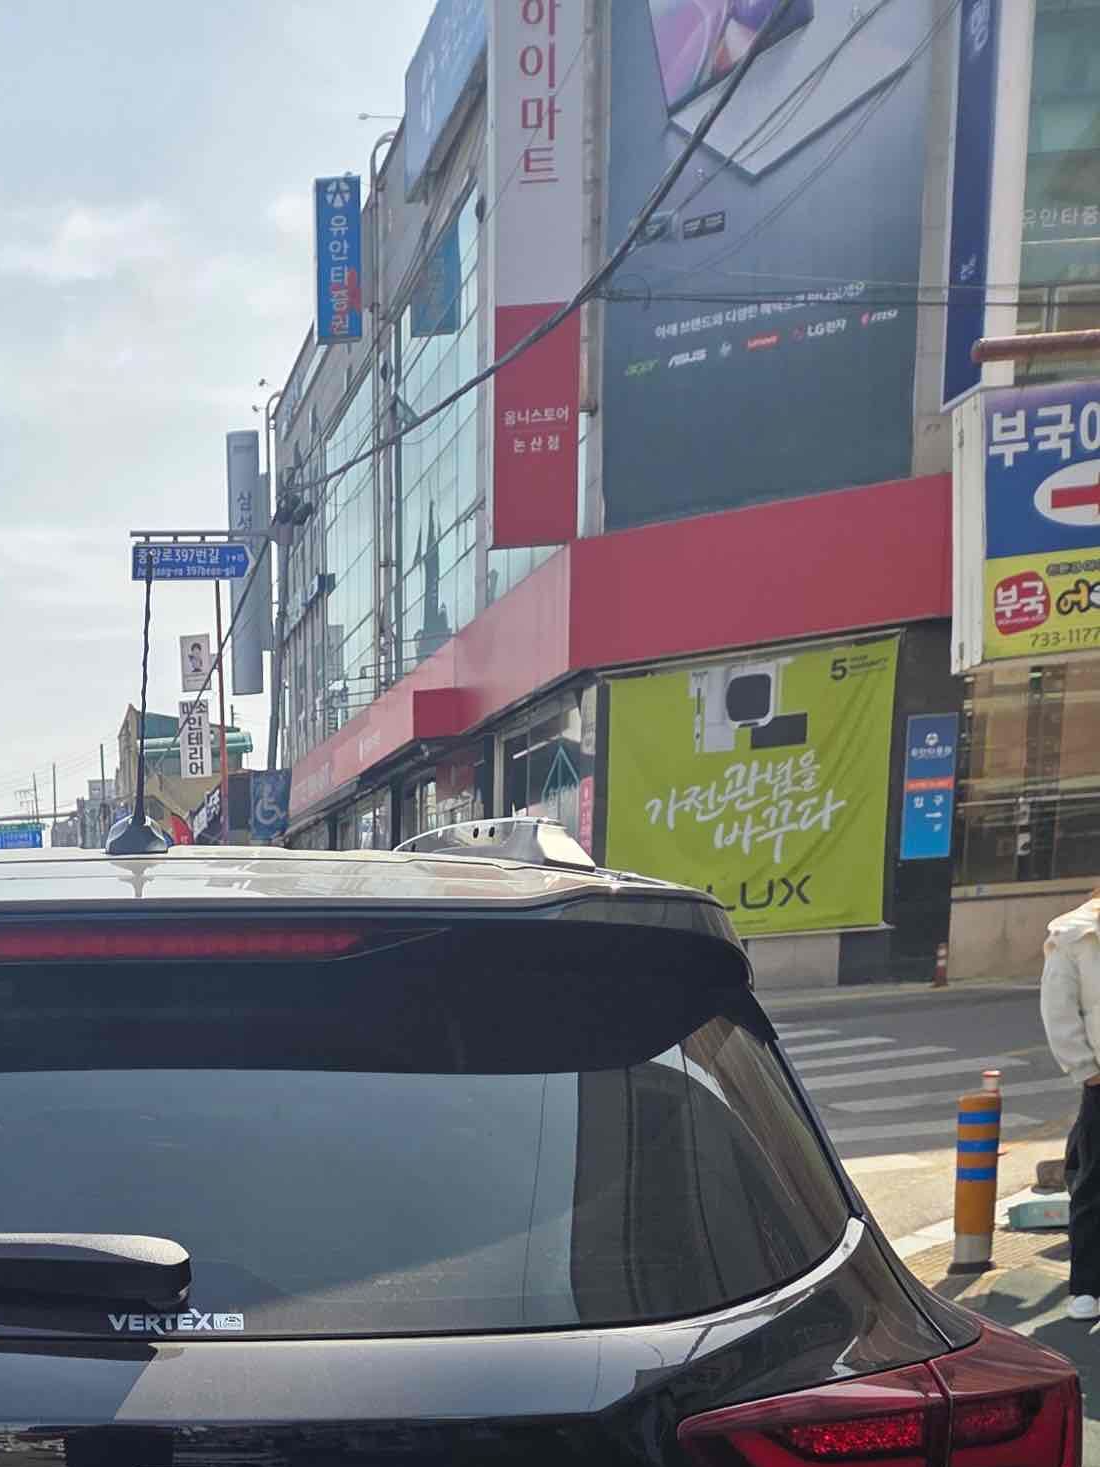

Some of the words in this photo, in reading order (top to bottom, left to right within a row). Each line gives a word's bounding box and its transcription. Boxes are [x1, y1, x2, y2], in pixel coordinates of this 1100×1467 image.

[667, 348, 707, 369] ASUS
[504, 404, 569, 425] 옴니스토어
[995, 580, 1047, 619] 부국
[829, 657, 848, 681] 5
[187, 716, 204, 776] 인테리어
[712, 788, 848, 865] 바꾸다
[107, 1307, 213, 1336] VERTEX
